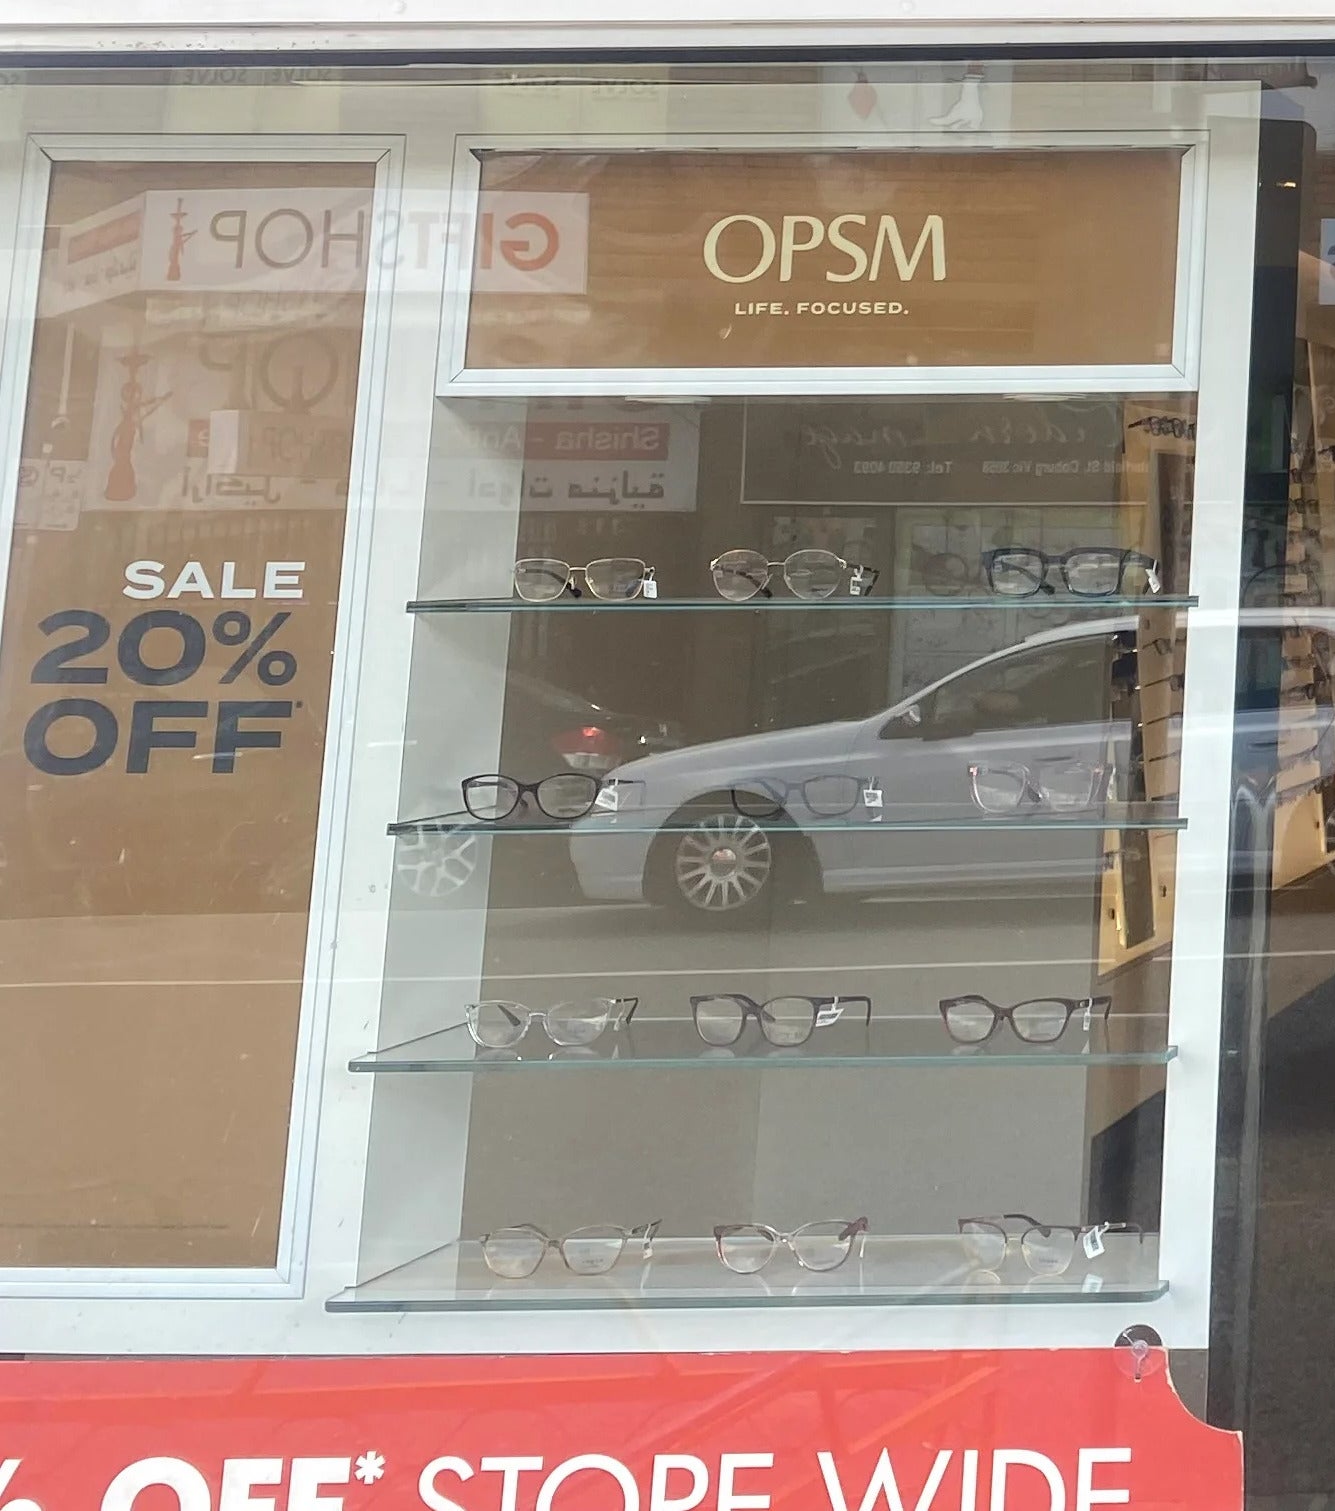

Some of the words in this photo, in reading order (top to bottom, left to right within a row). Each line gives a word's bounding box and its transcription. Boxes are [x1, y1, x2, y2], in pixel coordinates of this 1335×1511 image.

[702, 213, 948, 285] OPSM
[734, 301, 790, 317] LIFE.
[796, 301, 911, 317] FOCUSED.
[122, 559, 306, 600] SALE
[30, 609, 298, 687] 20%
